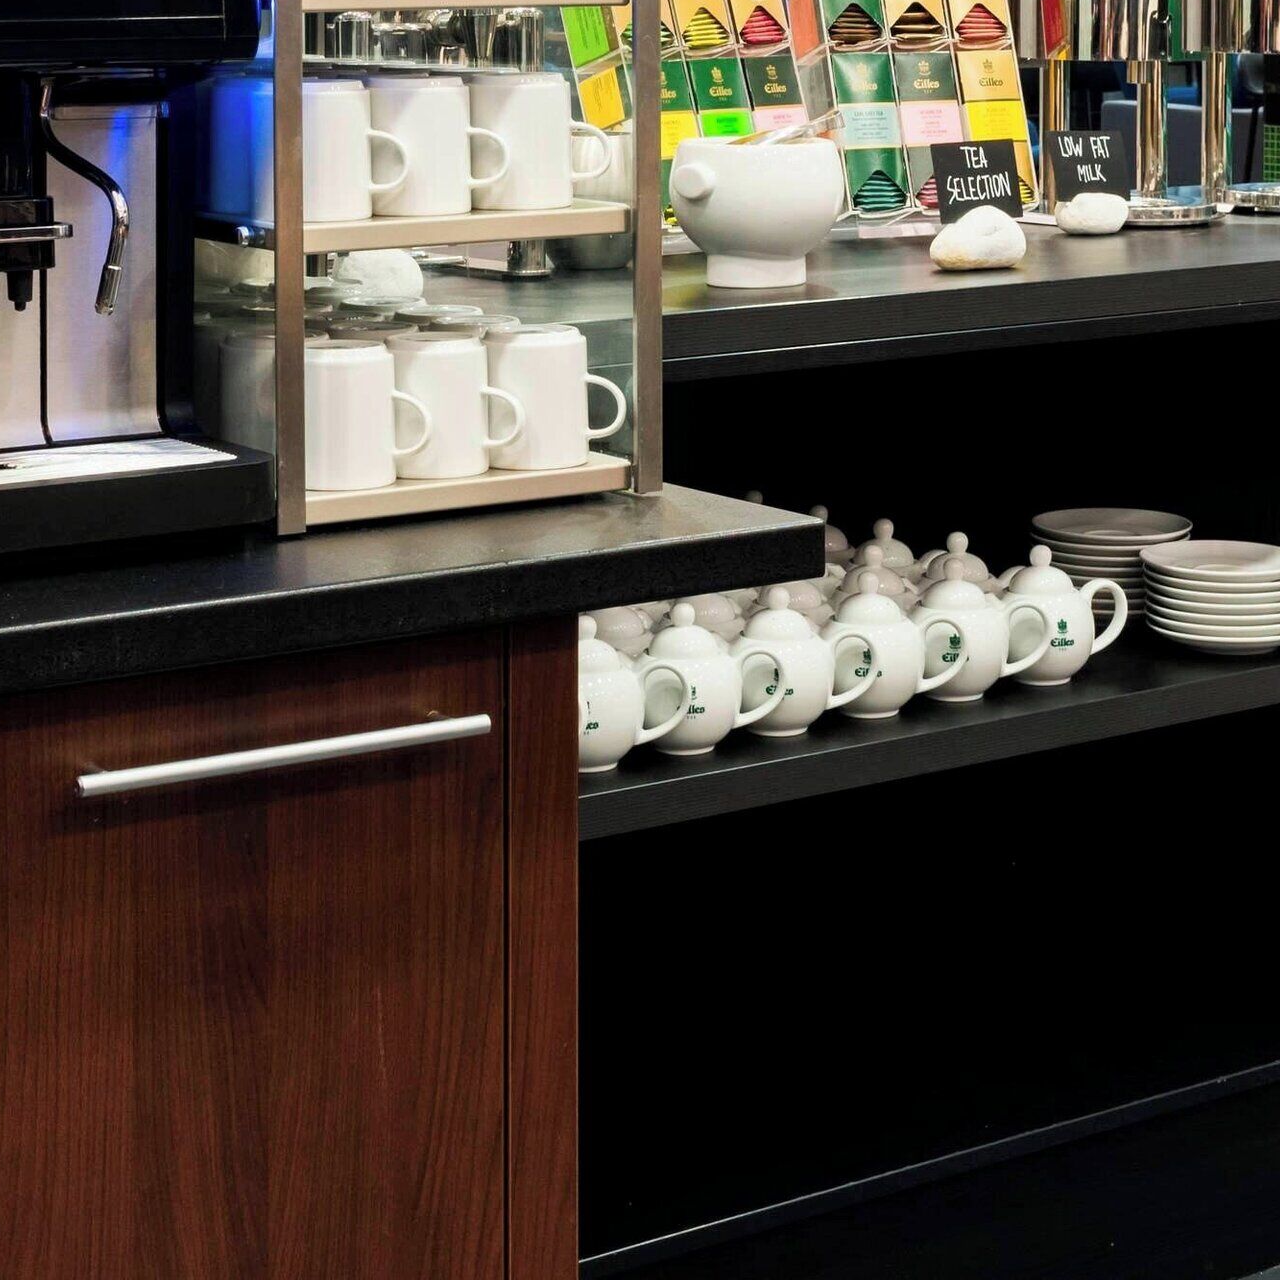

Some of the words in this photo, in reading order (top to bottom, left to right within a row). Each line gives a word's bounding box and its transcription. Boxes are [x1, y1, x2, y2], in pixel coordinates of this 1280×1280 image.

[914, 78, 940, 89] Eilles
[979, 77, 1004, 87] Eilles
[709, 86, 733, 98] Eilles
[764, 83, 787, 94] Eilles
[1058, 136, 1083, 158] LOW
[1090, 136, 1111, 159] FAT
[959, 146, 988, 169] TEA
[1077, 164, 1107, 183] MILK
[946, 171, 1012, 205] SELECTION
[1049, 637, 1074, 648] Eilles
